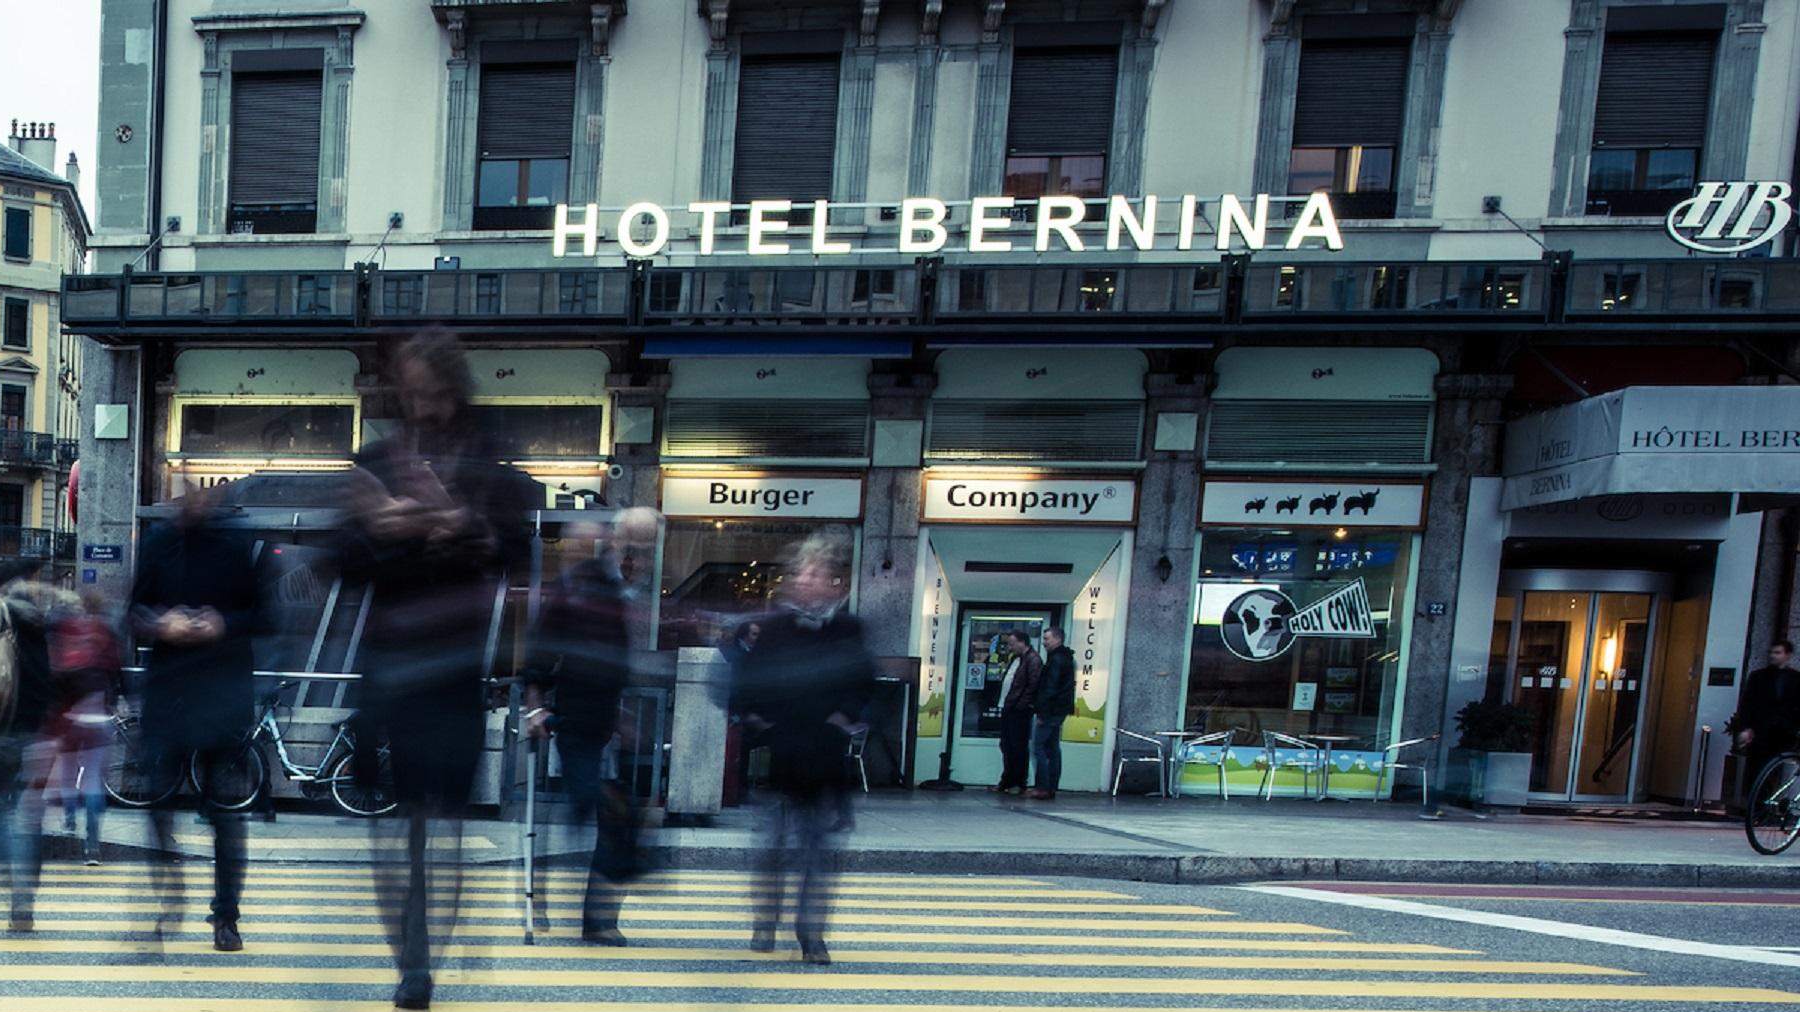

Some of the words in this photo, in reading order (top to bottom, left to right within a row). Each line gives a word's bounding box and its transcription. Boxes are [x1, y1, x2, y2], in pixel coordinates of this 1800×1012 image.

[552, 199, 851, 257] HOTEL
[899, 192, 1345, 253] BERNINA
[1631, 425, 1731, 448] HÔTEL
[708, 482, 815, 511] Burger
[1291, 605, 1325, 632] HOLY
[1328, 582, 1370, 632] COW!
[1430, 604, 1444, 614] 22
[928, 578, 942, 691] BIENVENUE
[1082, 587, 1101, 691] WELCOME
